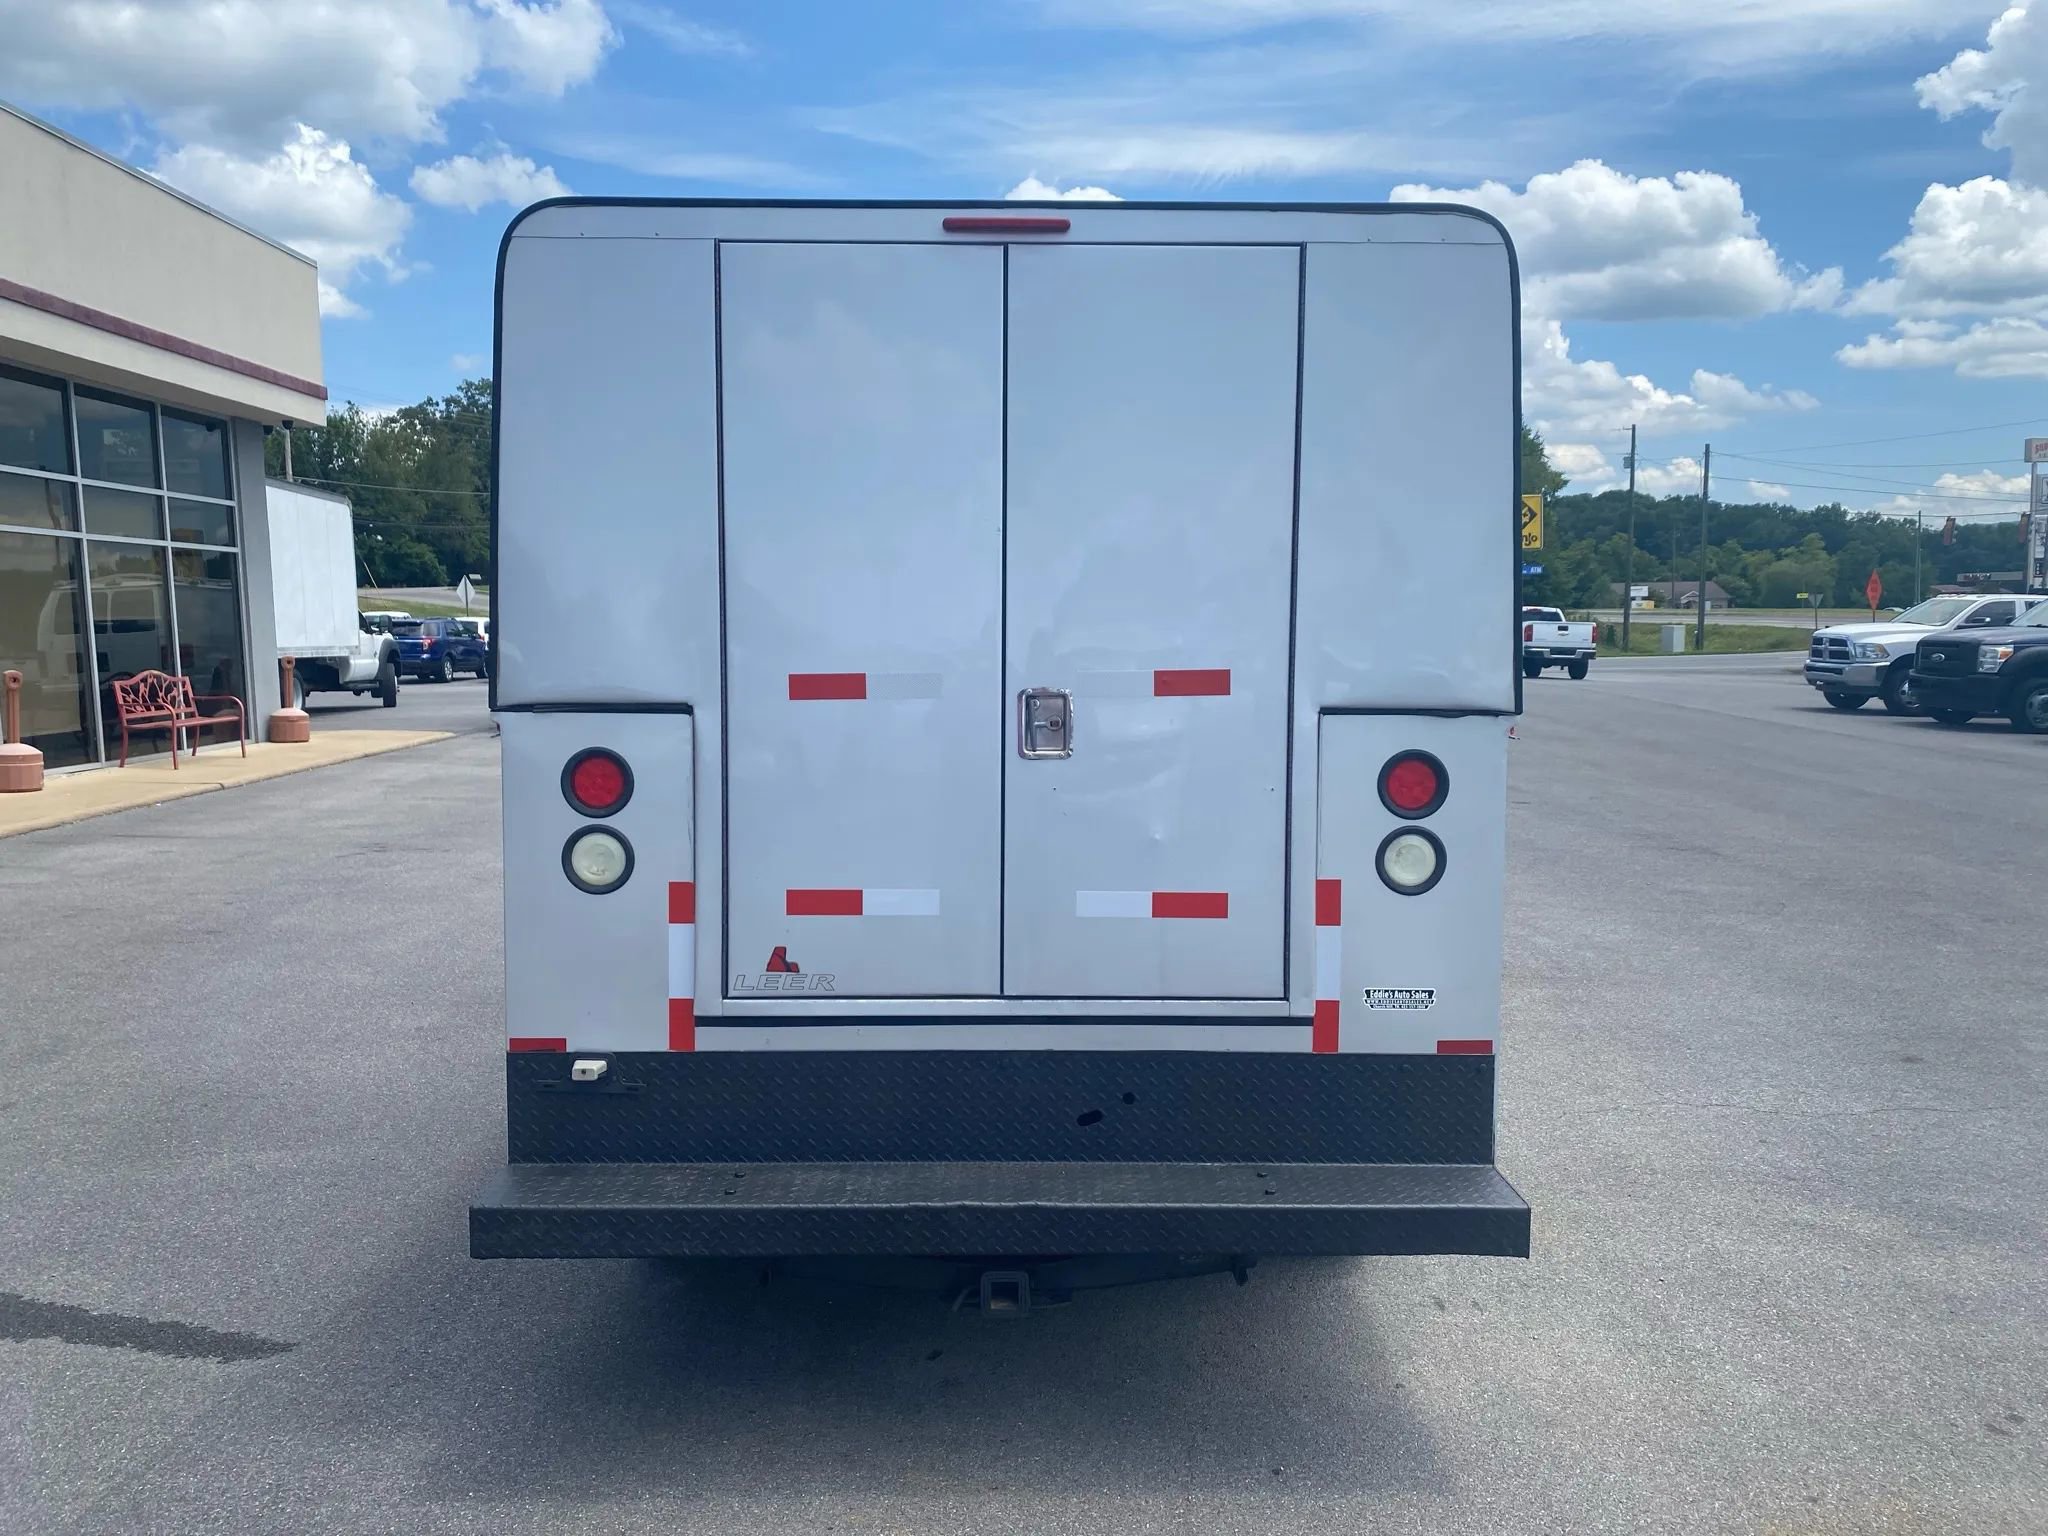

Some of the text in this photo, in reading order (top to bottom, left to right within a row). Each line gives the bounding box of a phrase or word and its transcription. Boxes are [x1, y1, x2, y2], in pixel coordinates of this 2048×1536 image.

[1522, 533, 1538, 546] njo
[733, 973, 836, 992] LEER
[1370, 990, 1429, 999] Eddie's Auto Sales
